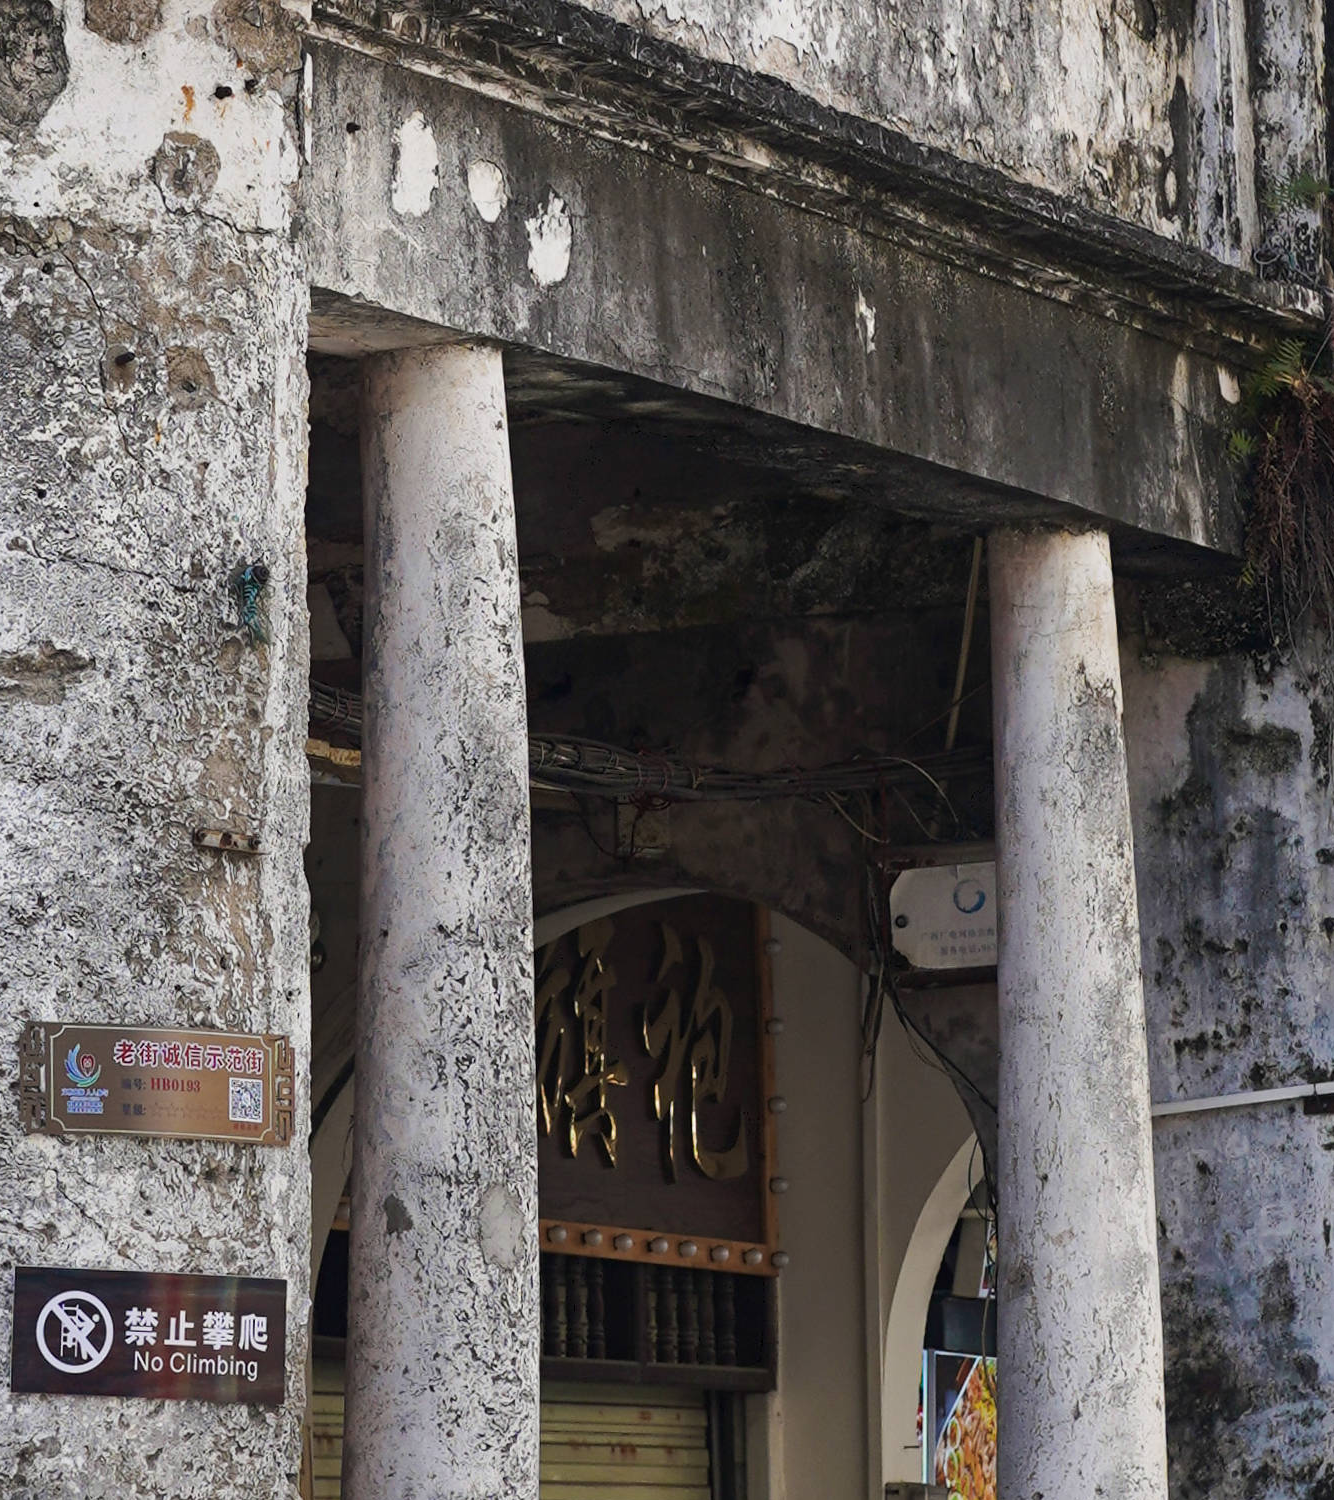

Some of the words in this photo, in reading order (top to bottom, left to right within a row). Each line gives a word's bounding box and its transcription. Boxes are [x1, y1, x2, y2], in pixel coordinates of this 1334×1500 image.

[114, 1040, 264, 1074] 老街诚信示范街
[150, 1076, 201, 1093] HB0193
[124, 1306, 268, 1352] 禁止攀爬
[133, 1350, 164, 1372] No
[169, 1351, 258, 1382] Climbing
